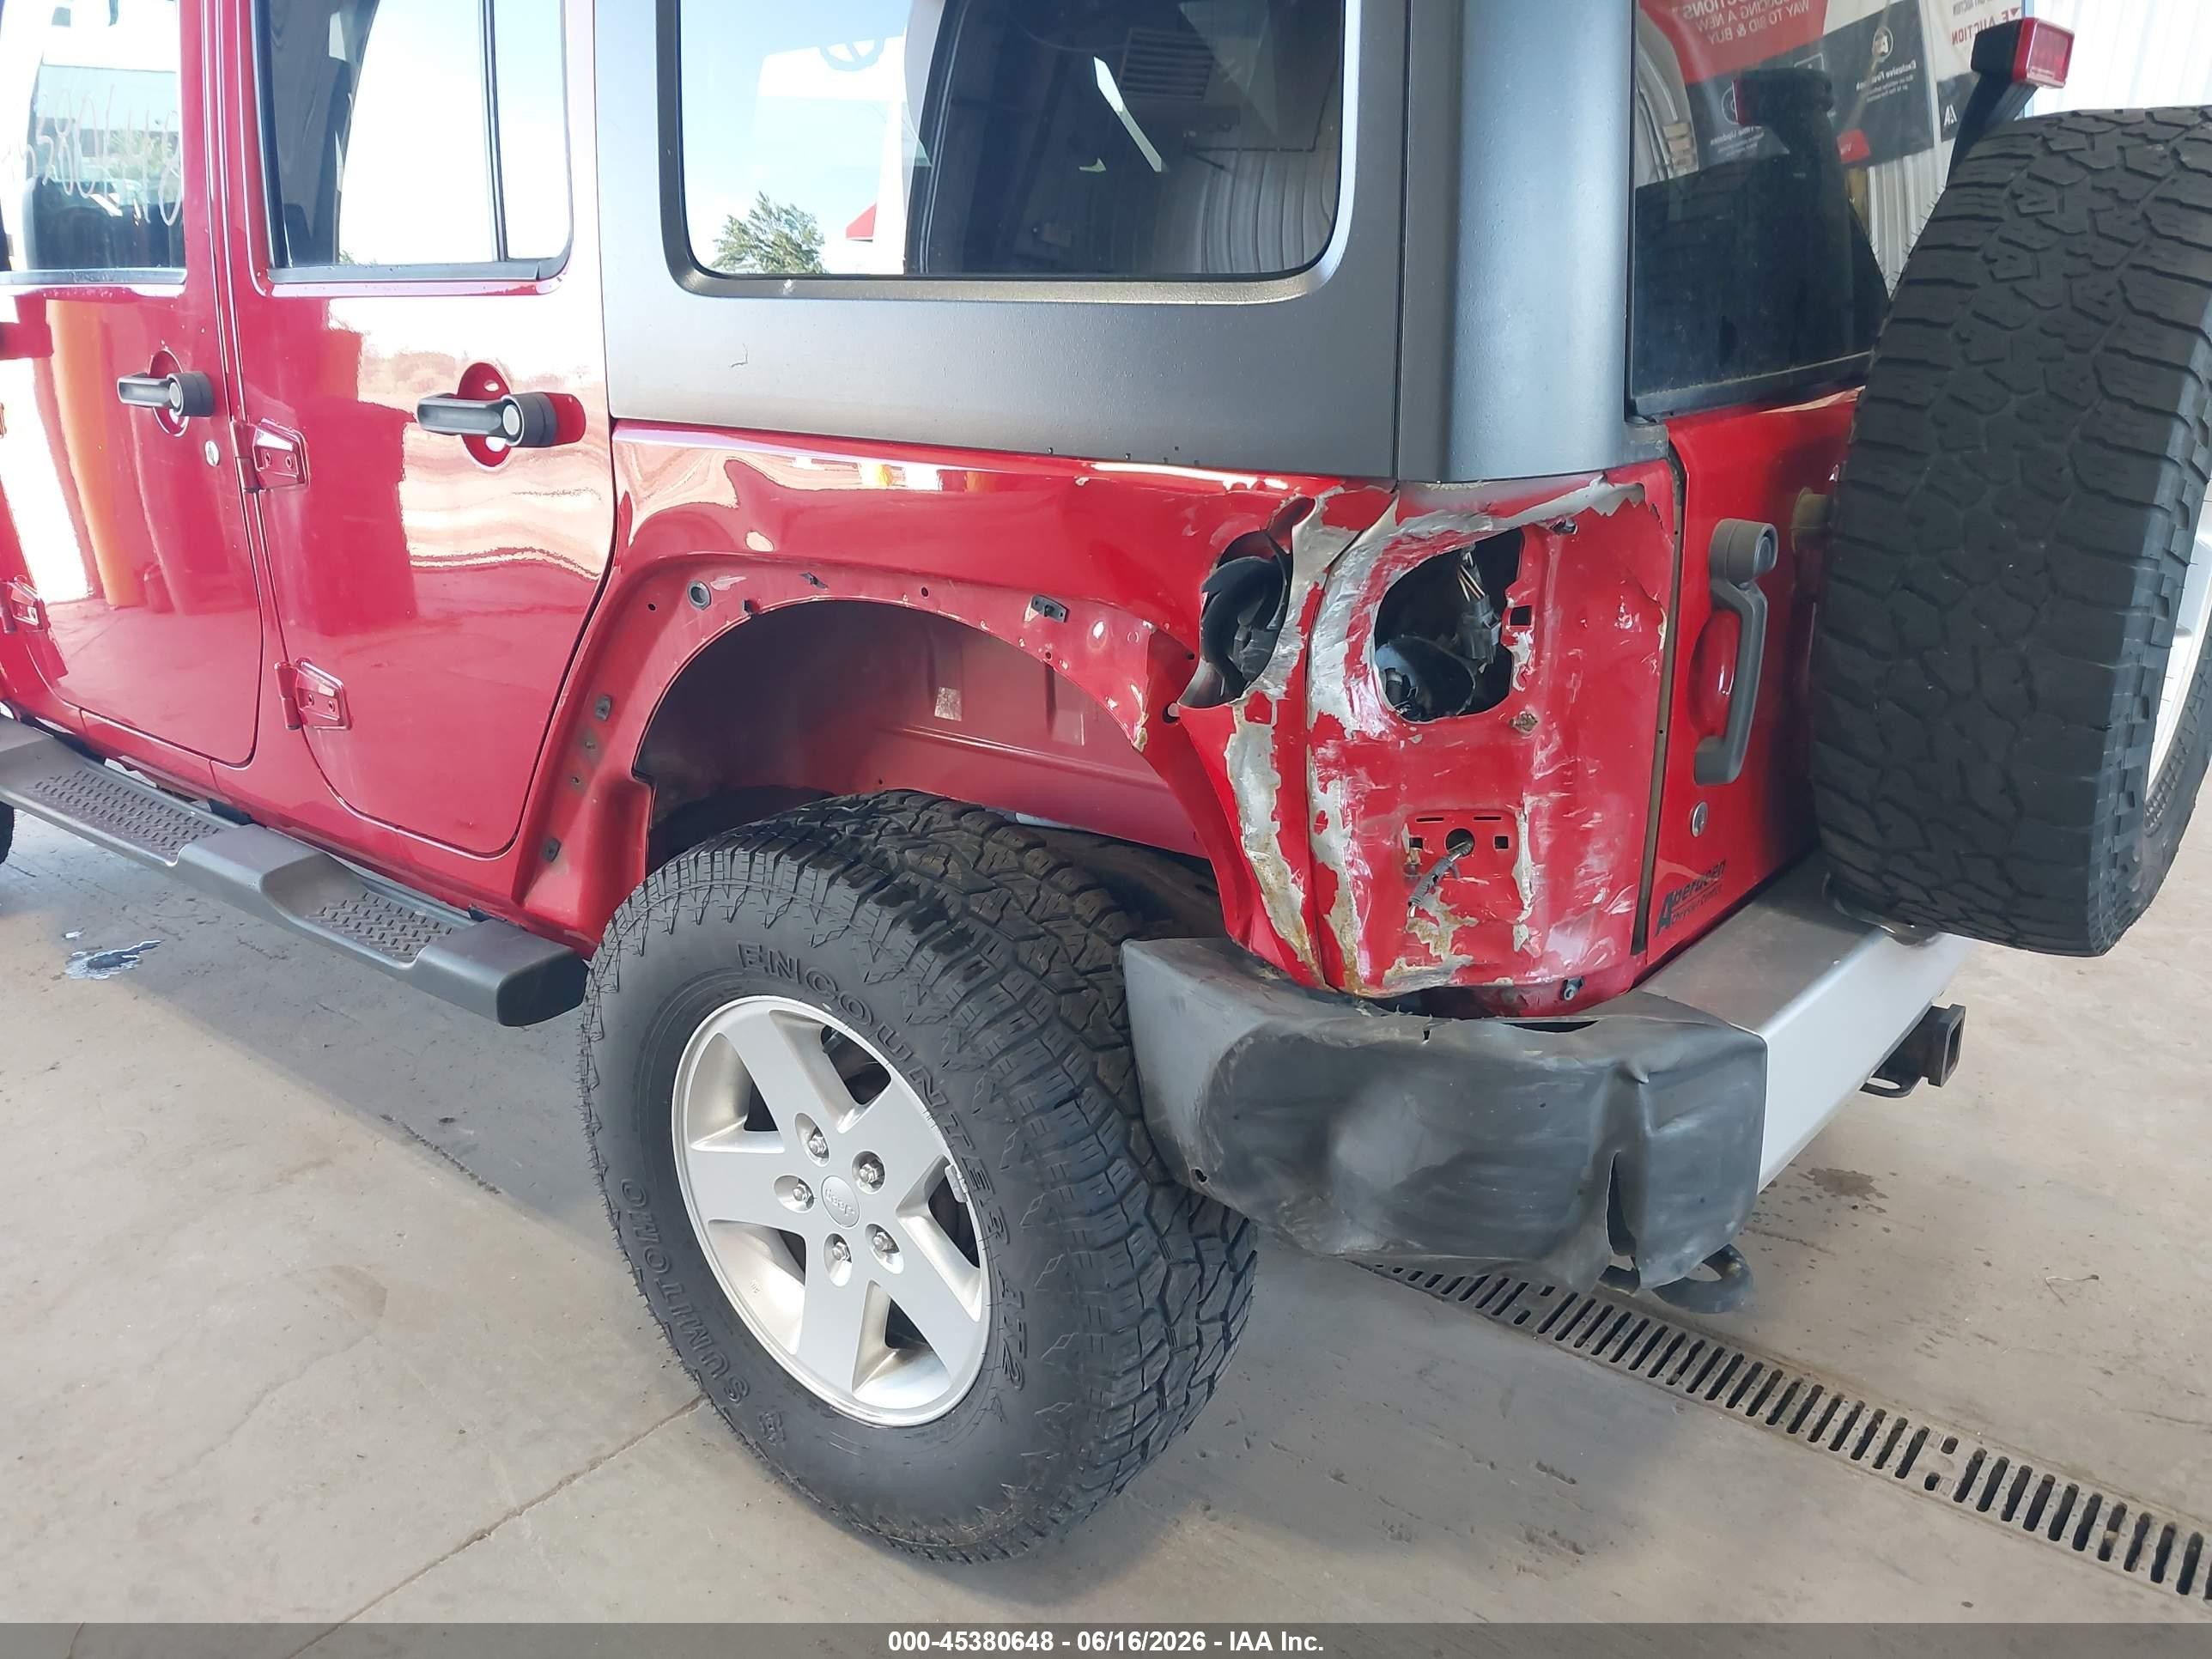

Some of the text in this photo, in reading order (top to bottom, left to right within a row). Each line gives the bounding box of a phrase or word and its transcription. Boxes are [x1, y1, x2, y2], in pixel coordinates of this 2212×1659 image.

[737, 939, 1012, 1247] ENCOUNTER
[824, 1188, 855, 1217] Jeep
[620, 1176, 750, 1406] SUMITOMO
